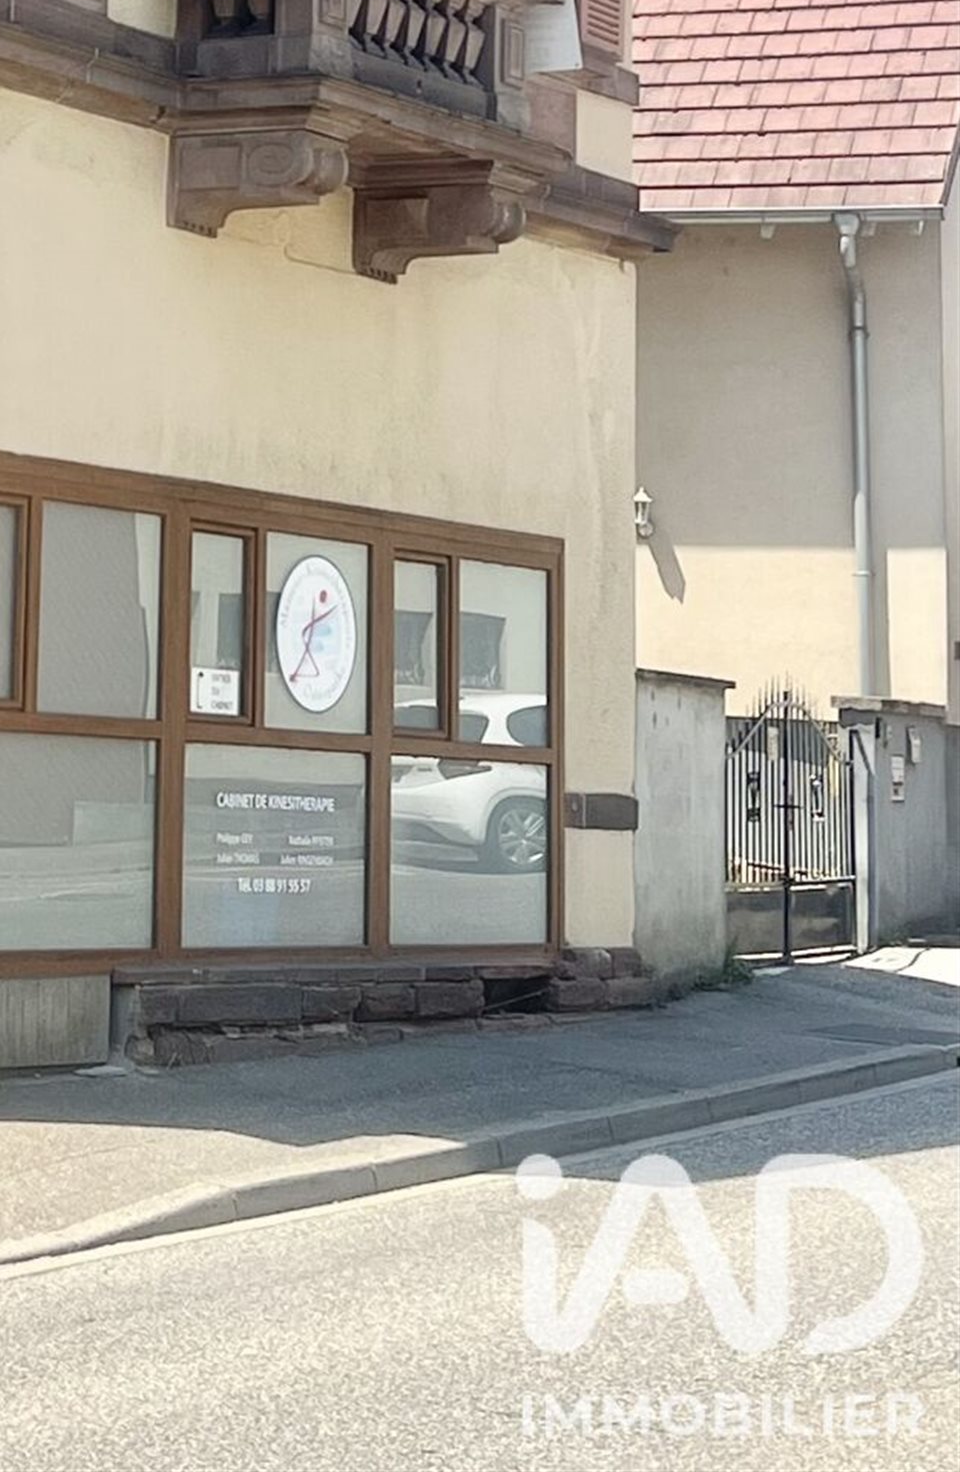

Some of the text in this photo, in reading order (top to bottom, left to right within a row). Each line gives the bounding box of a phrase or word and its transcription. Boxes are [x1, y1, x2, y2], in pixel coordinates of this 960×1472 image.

[216, 792, 335, 812] CABINET DE KINESITHERAPIE
[265, 879, 276, 892] 88
[277, 879, 287, 892] 91
